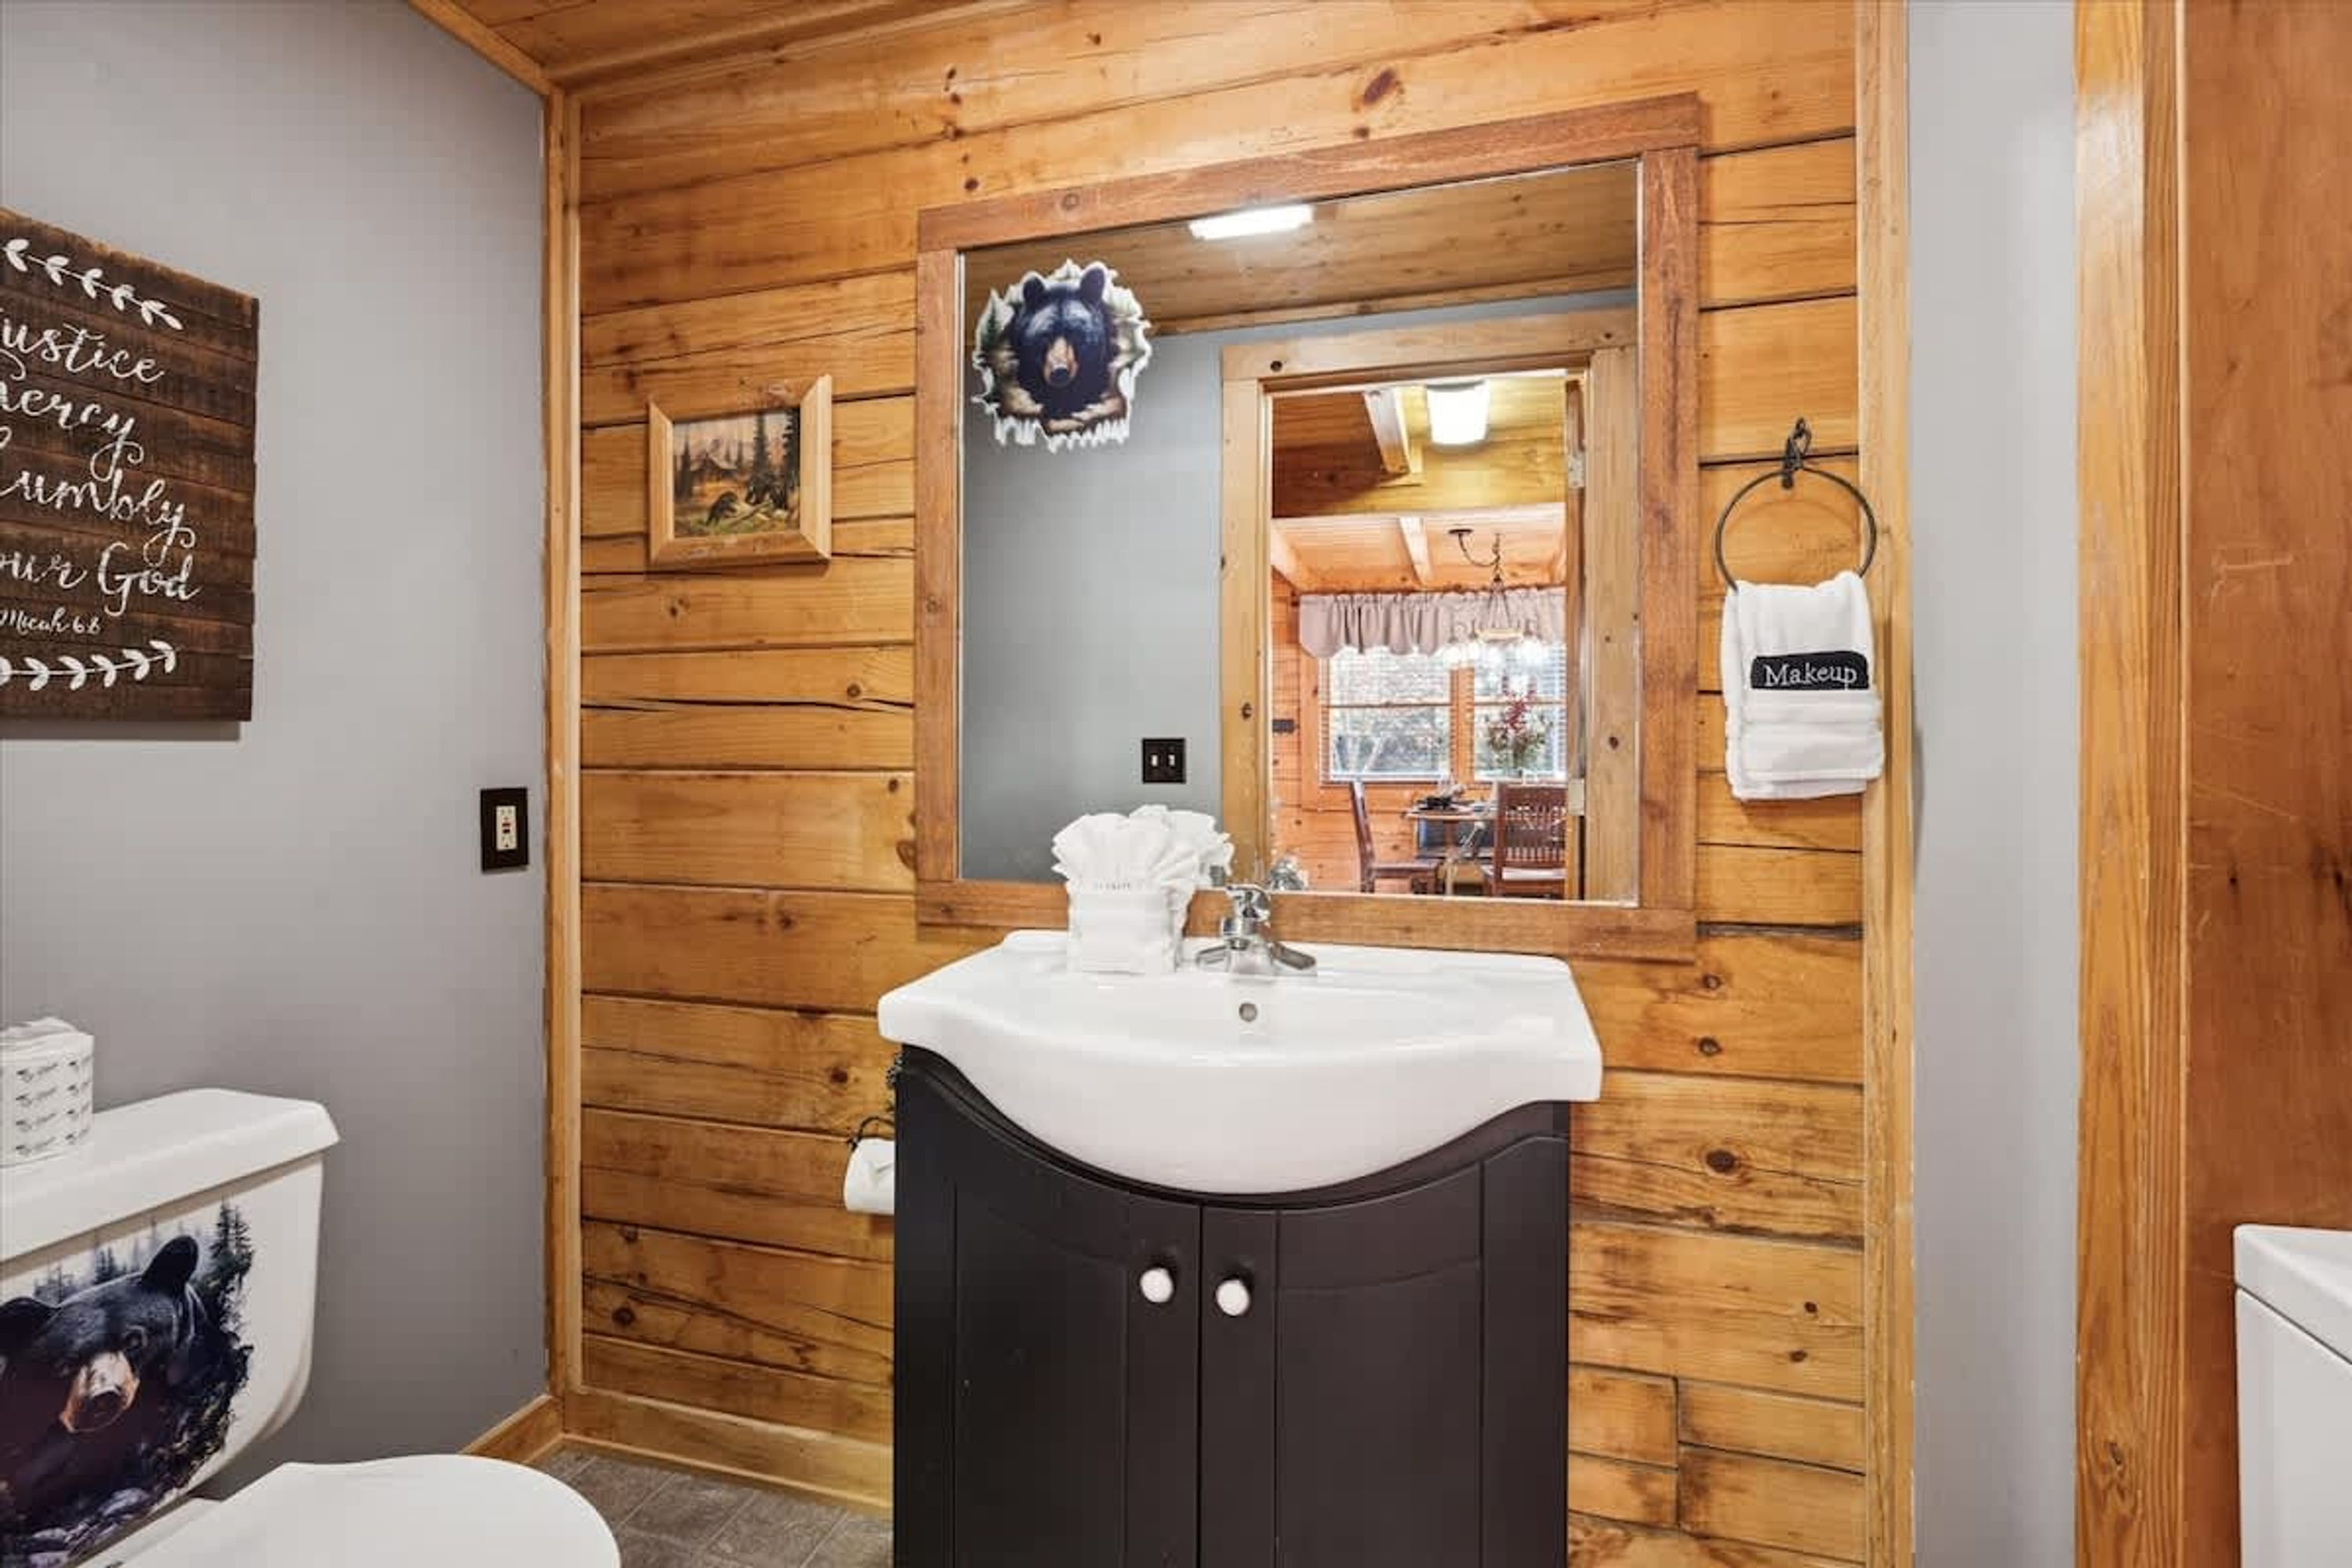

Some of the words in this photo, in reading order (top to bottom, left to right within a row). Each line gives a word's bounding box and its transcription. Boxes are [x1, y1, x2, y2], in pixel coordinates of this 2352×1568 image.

[0, 312, 165, 383] ustice
[0, 468, 196, 567] umbly
[98, 542, 201, 616] God
[0, 607, 71, 636] Micah
[1763, 663, 1858, 691] Makeup
